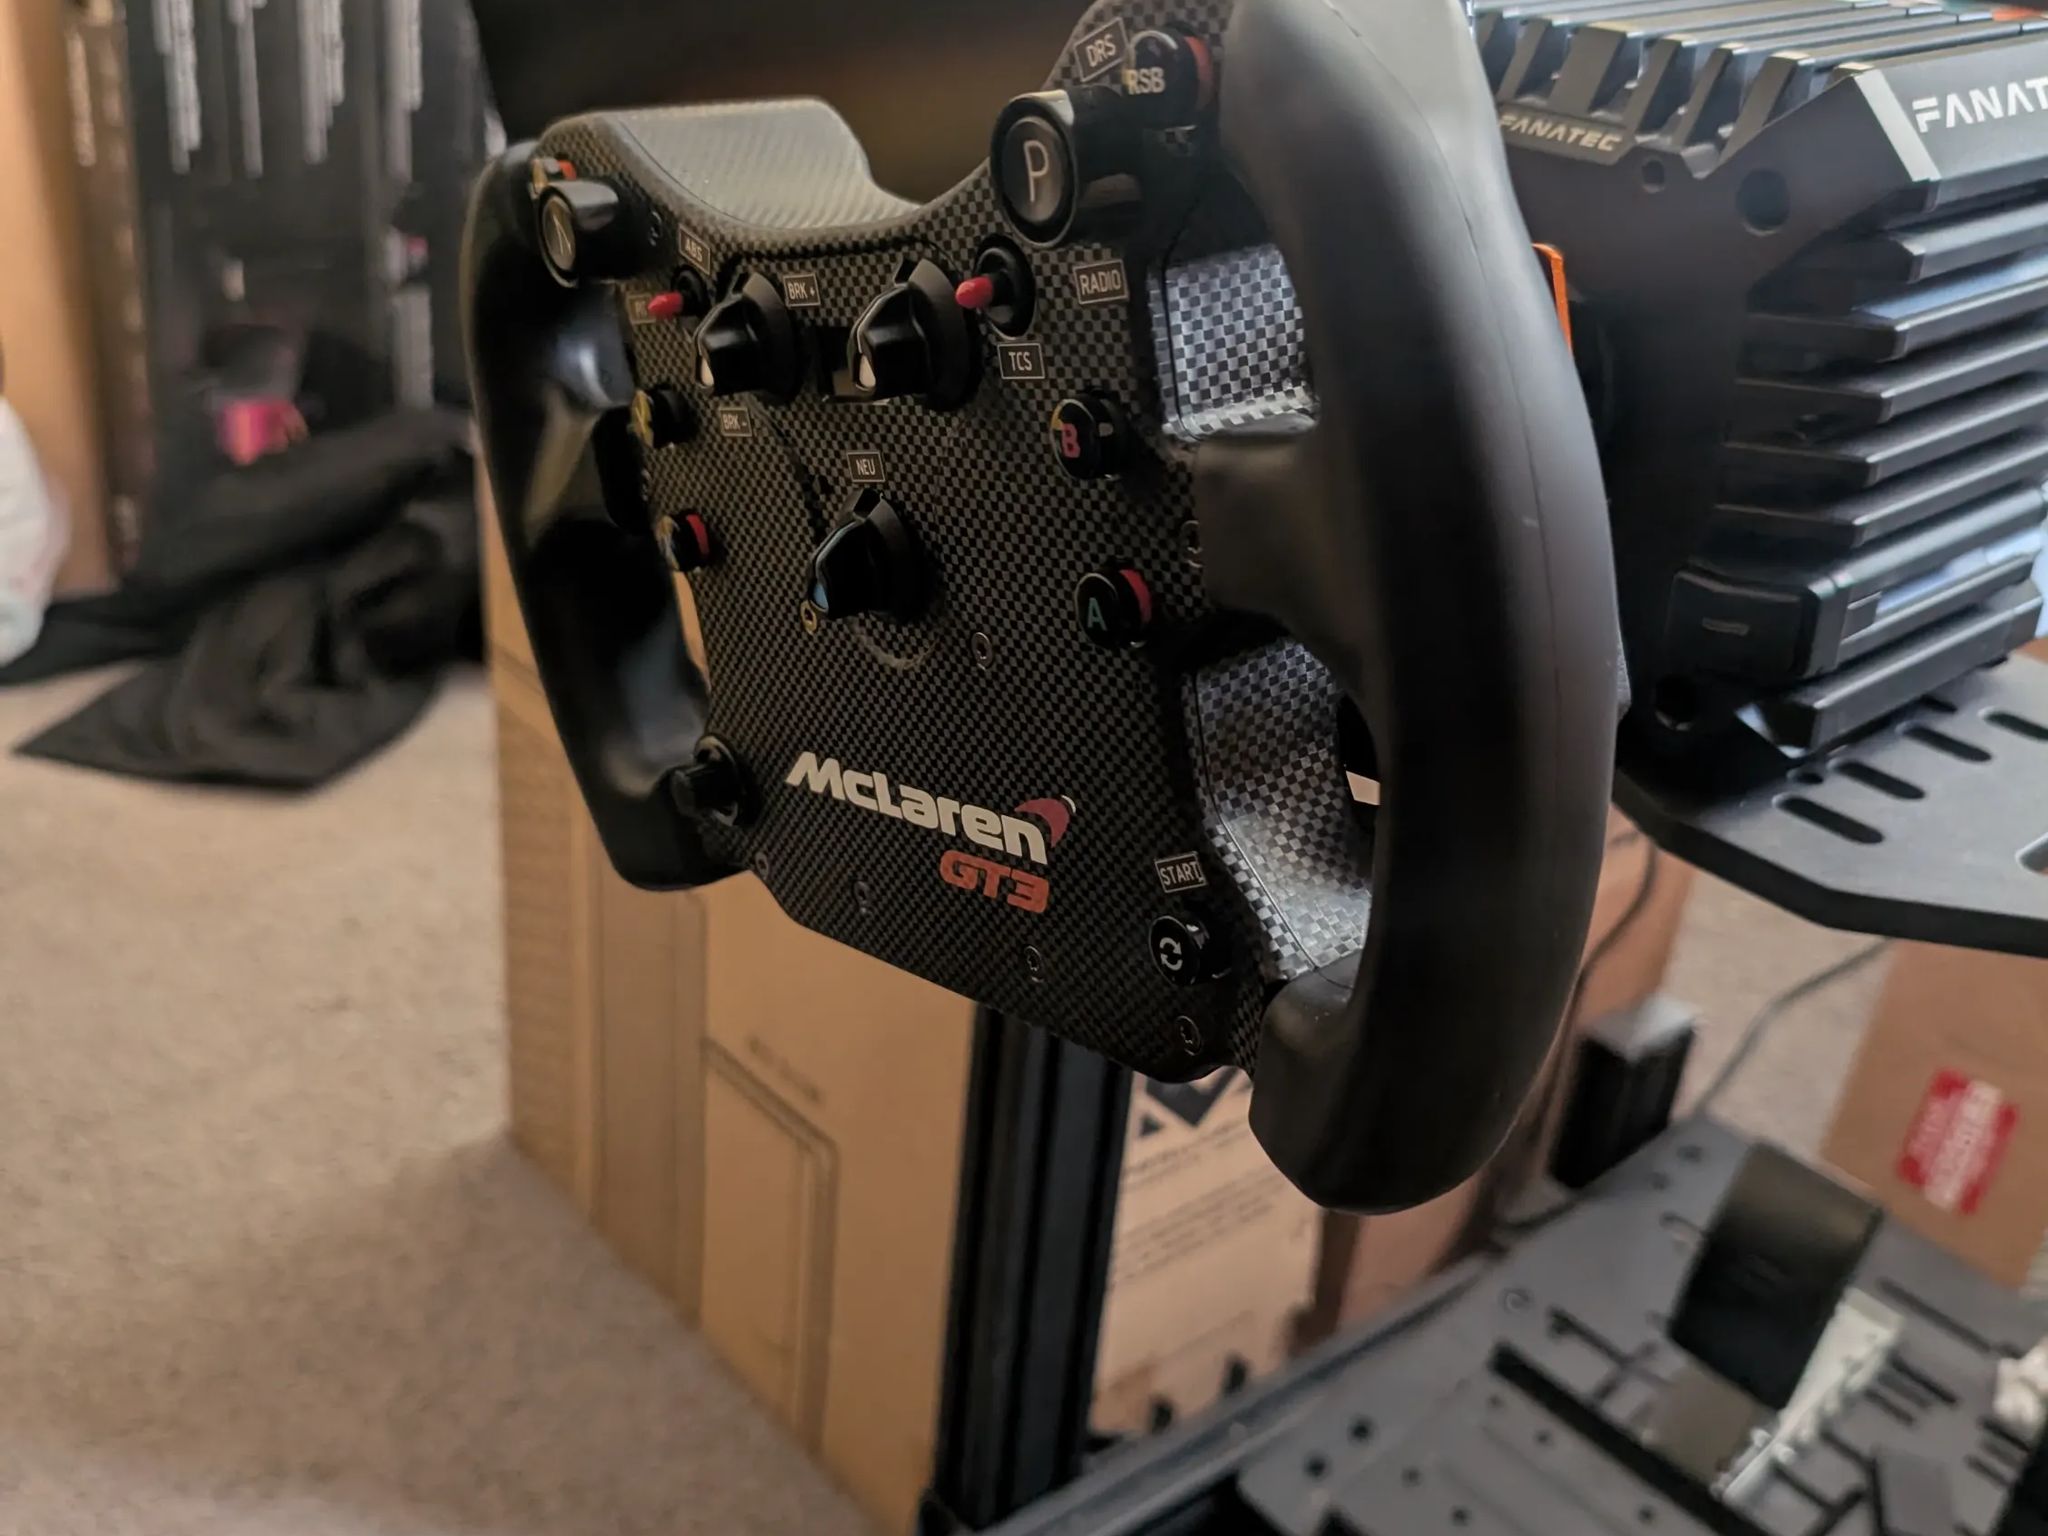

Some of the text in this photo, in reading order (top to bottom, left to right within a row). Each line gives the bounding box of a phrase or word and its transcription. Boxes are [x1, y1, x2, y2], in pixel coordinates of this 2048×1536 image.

[1086, 33, 1117, 68] DRS
[1123, 66, 1166, 95] RSB
[1498, 113, 1622, 151] FANATEC
[1022, 139, 1049, 203] P
[684, 238, 704, 263] ABS
[787, 282, 809, 300] BRK
[1079, 269, 1122, 296] RADIO
[1008, 351, 1033, 372] TCS
[722, 414, 741, 430] BRK
[1061, 422, 1081, 459] B
[856, 458, 876, 477] NEU
[1087, 596, 1106, 631] A
[785, 751, 1048, 865] McLaren
[939, 849, 1050, 914] GT3
[1160, 861, 1200, 886] START
